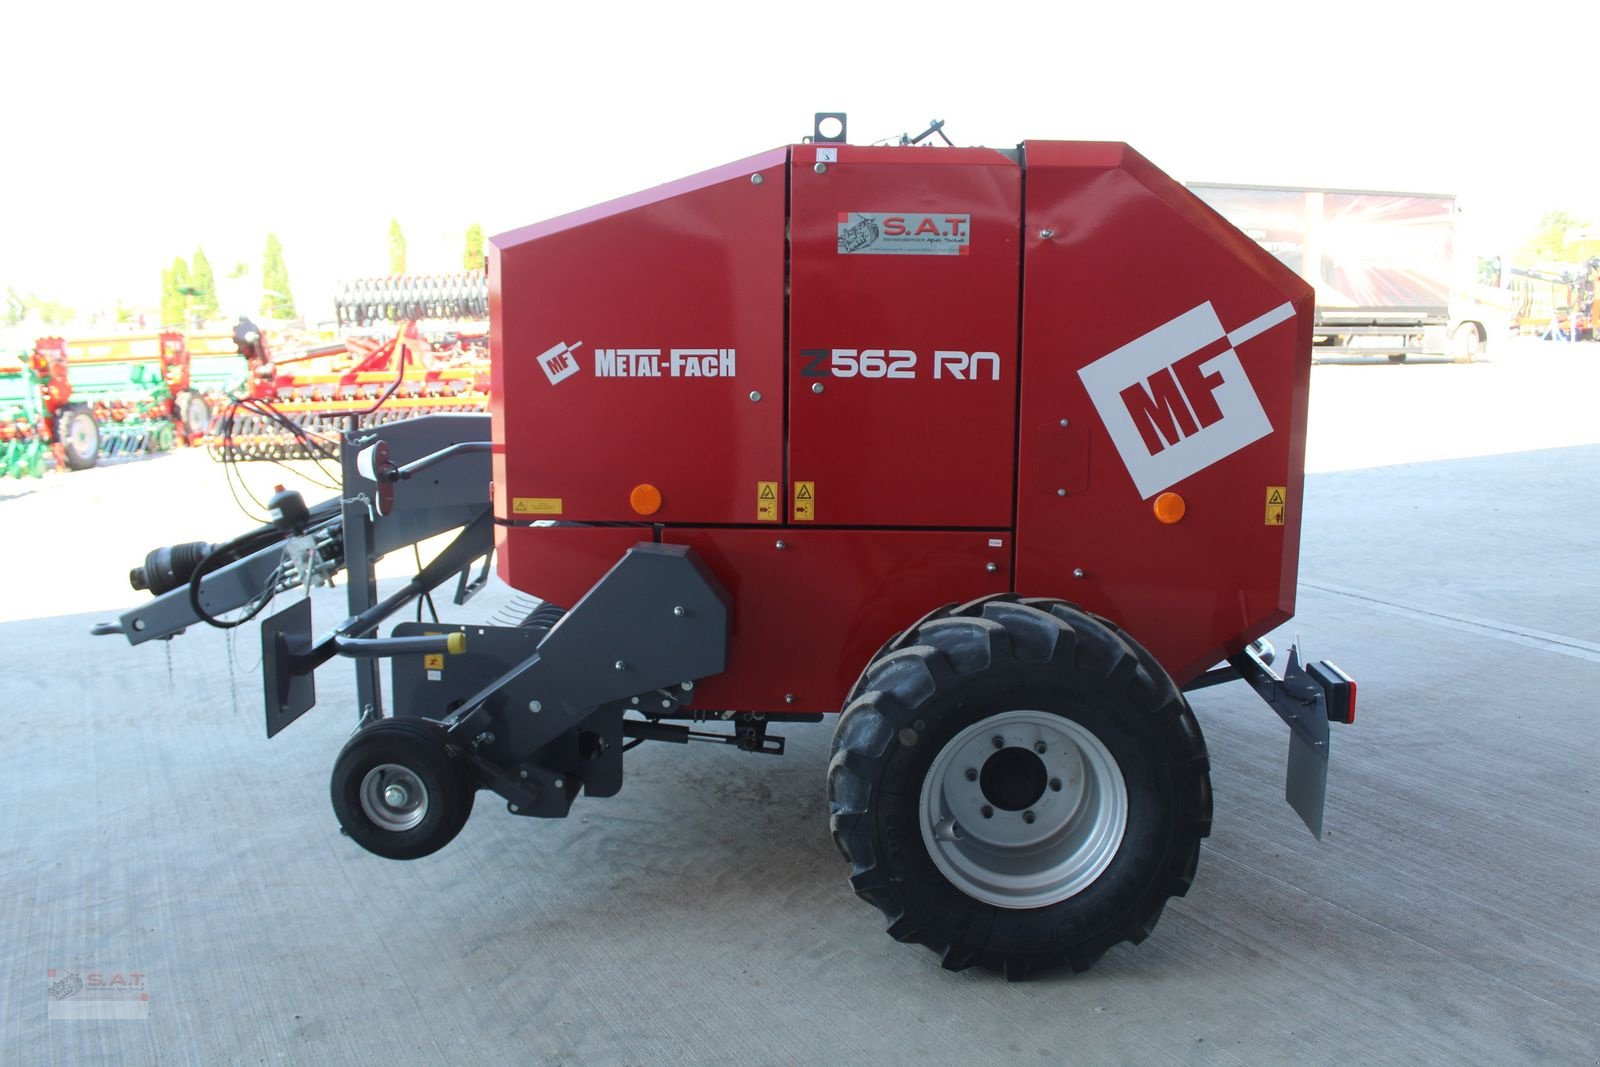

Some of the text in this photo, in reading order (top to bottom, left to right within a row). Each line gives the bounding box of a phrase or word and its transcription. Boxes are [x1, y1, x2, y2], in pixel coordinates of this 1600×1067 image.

[883, 216, 966, 237] S.A.T.
[546, 349, 569, 375] MF
[800, 348, 917, 379] Z562
[1118, 334, 1233, 456] MF
